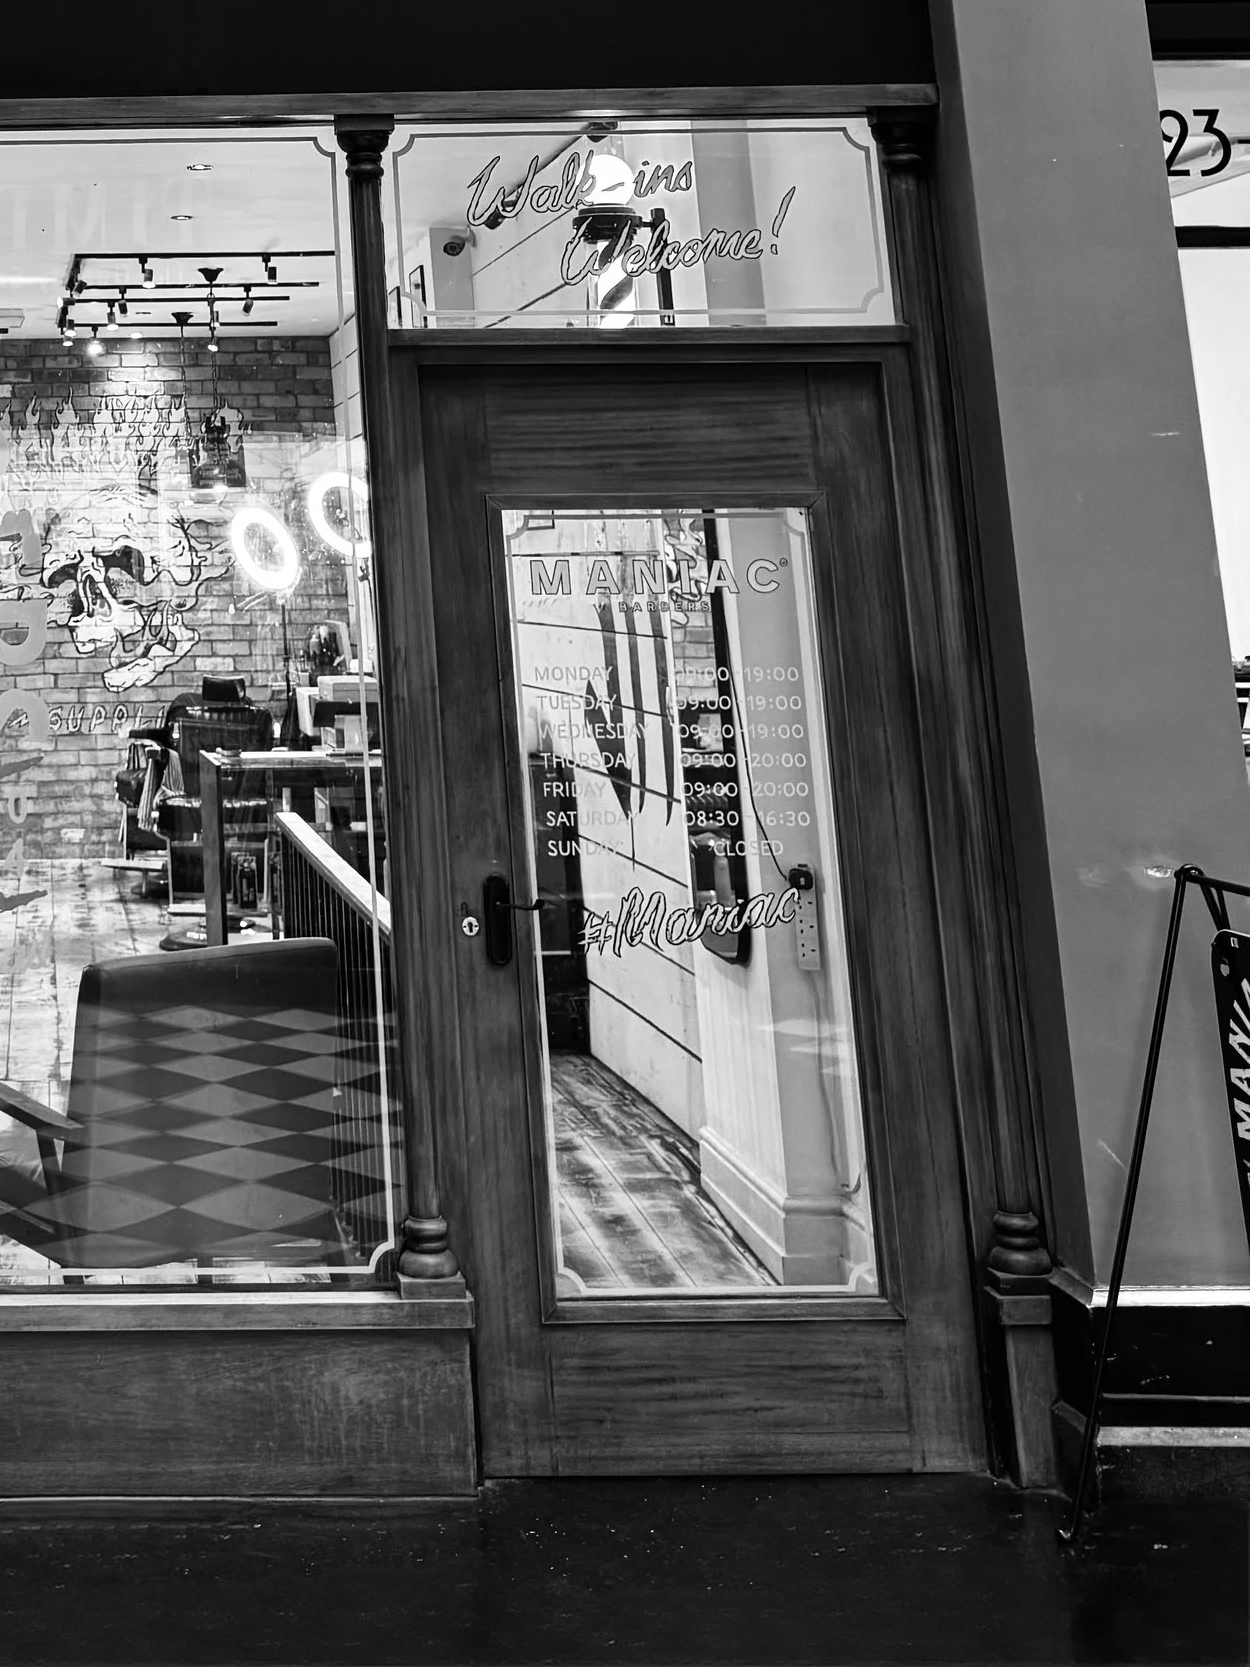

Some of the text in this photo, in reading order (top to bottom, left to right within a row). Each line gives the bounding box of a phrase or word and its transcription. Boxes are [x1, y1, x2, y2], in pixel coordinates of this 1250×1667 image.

[561, 186, 796, 286] Welcome!
[618, 600, 711, 613] BARBERS
[534, 666, 613, 682] MONDAY
[745, 667, 799, 682] 19:00
[535, 694, 617, 711] TUESDAY
[676, 695, 731, 710] 09:00
[748, 695, 802, 710] 19:00
[538, 722, 649, 739] WEDNESDAY
[678, 723, 734, 739] 09:00
[749, 723, 804, 739] 19:00
[540, 752, 636, 769] THURSDAY
[680, 753, 736, 768] 09:00
[751, 753, 807, 767] 20:00
[543, 781, 606, 797] FRIDAY
[682, 782, 738, 797] 09:00
[753, 782, 809, 797] 20:00
[546, 810, 638, 826] SATURDAY
[684, 811, 739, 826] 08:30
[714, 840, 784, 857] CLOSED
[577, 886, 800, 958] #Maniac
